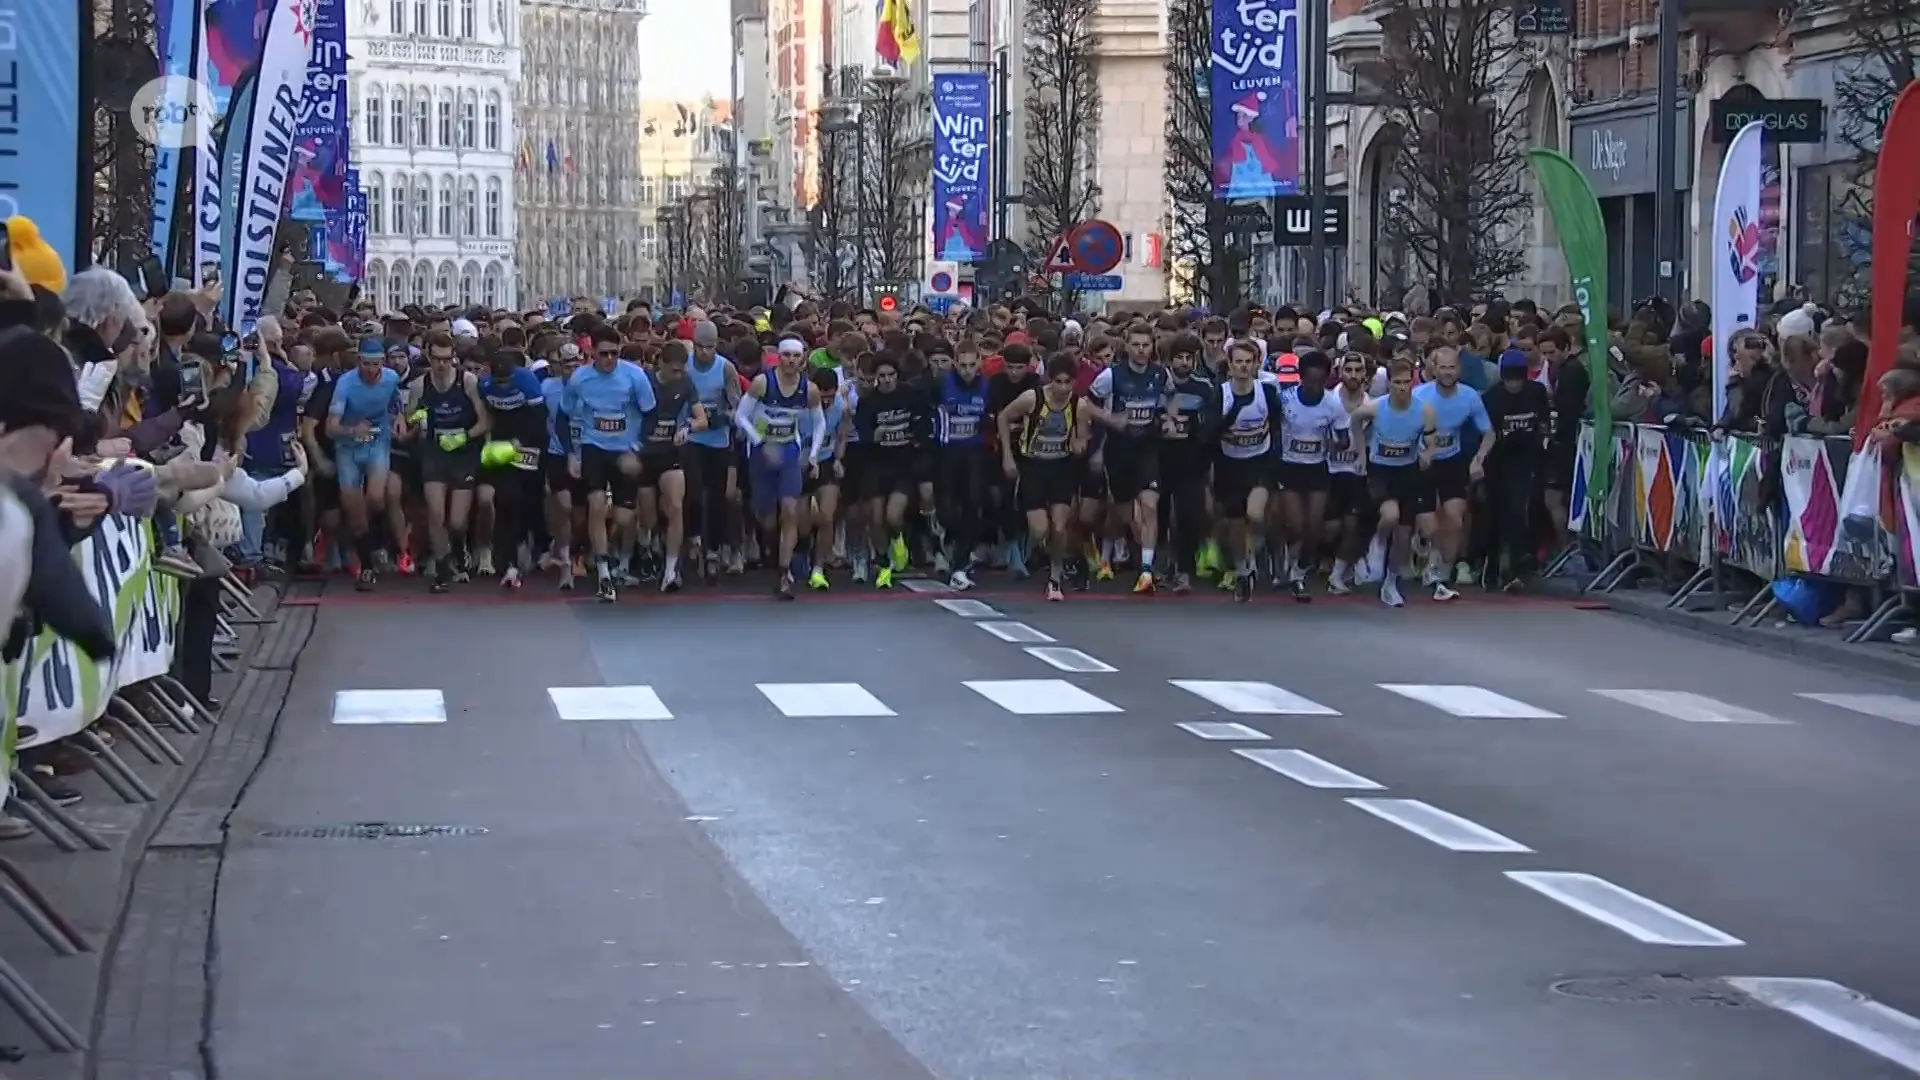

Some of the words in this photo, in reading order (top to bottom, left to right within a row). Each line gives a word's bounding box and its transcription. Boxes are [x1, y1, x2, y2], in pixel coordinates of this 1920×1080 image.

[1236, 0, 1297, 32] ter
[315, 37, 342, 68] in
[1212, 27, 1284, 76] tijd
[1232, 76, 1281, 91] LEUVEN
[932, 102, 984, 139] Win
[1726, 113, 1808, 130] DOGLAS
[949, 136, 989, 159] ter
[932, 153, 980, 184] tijd
